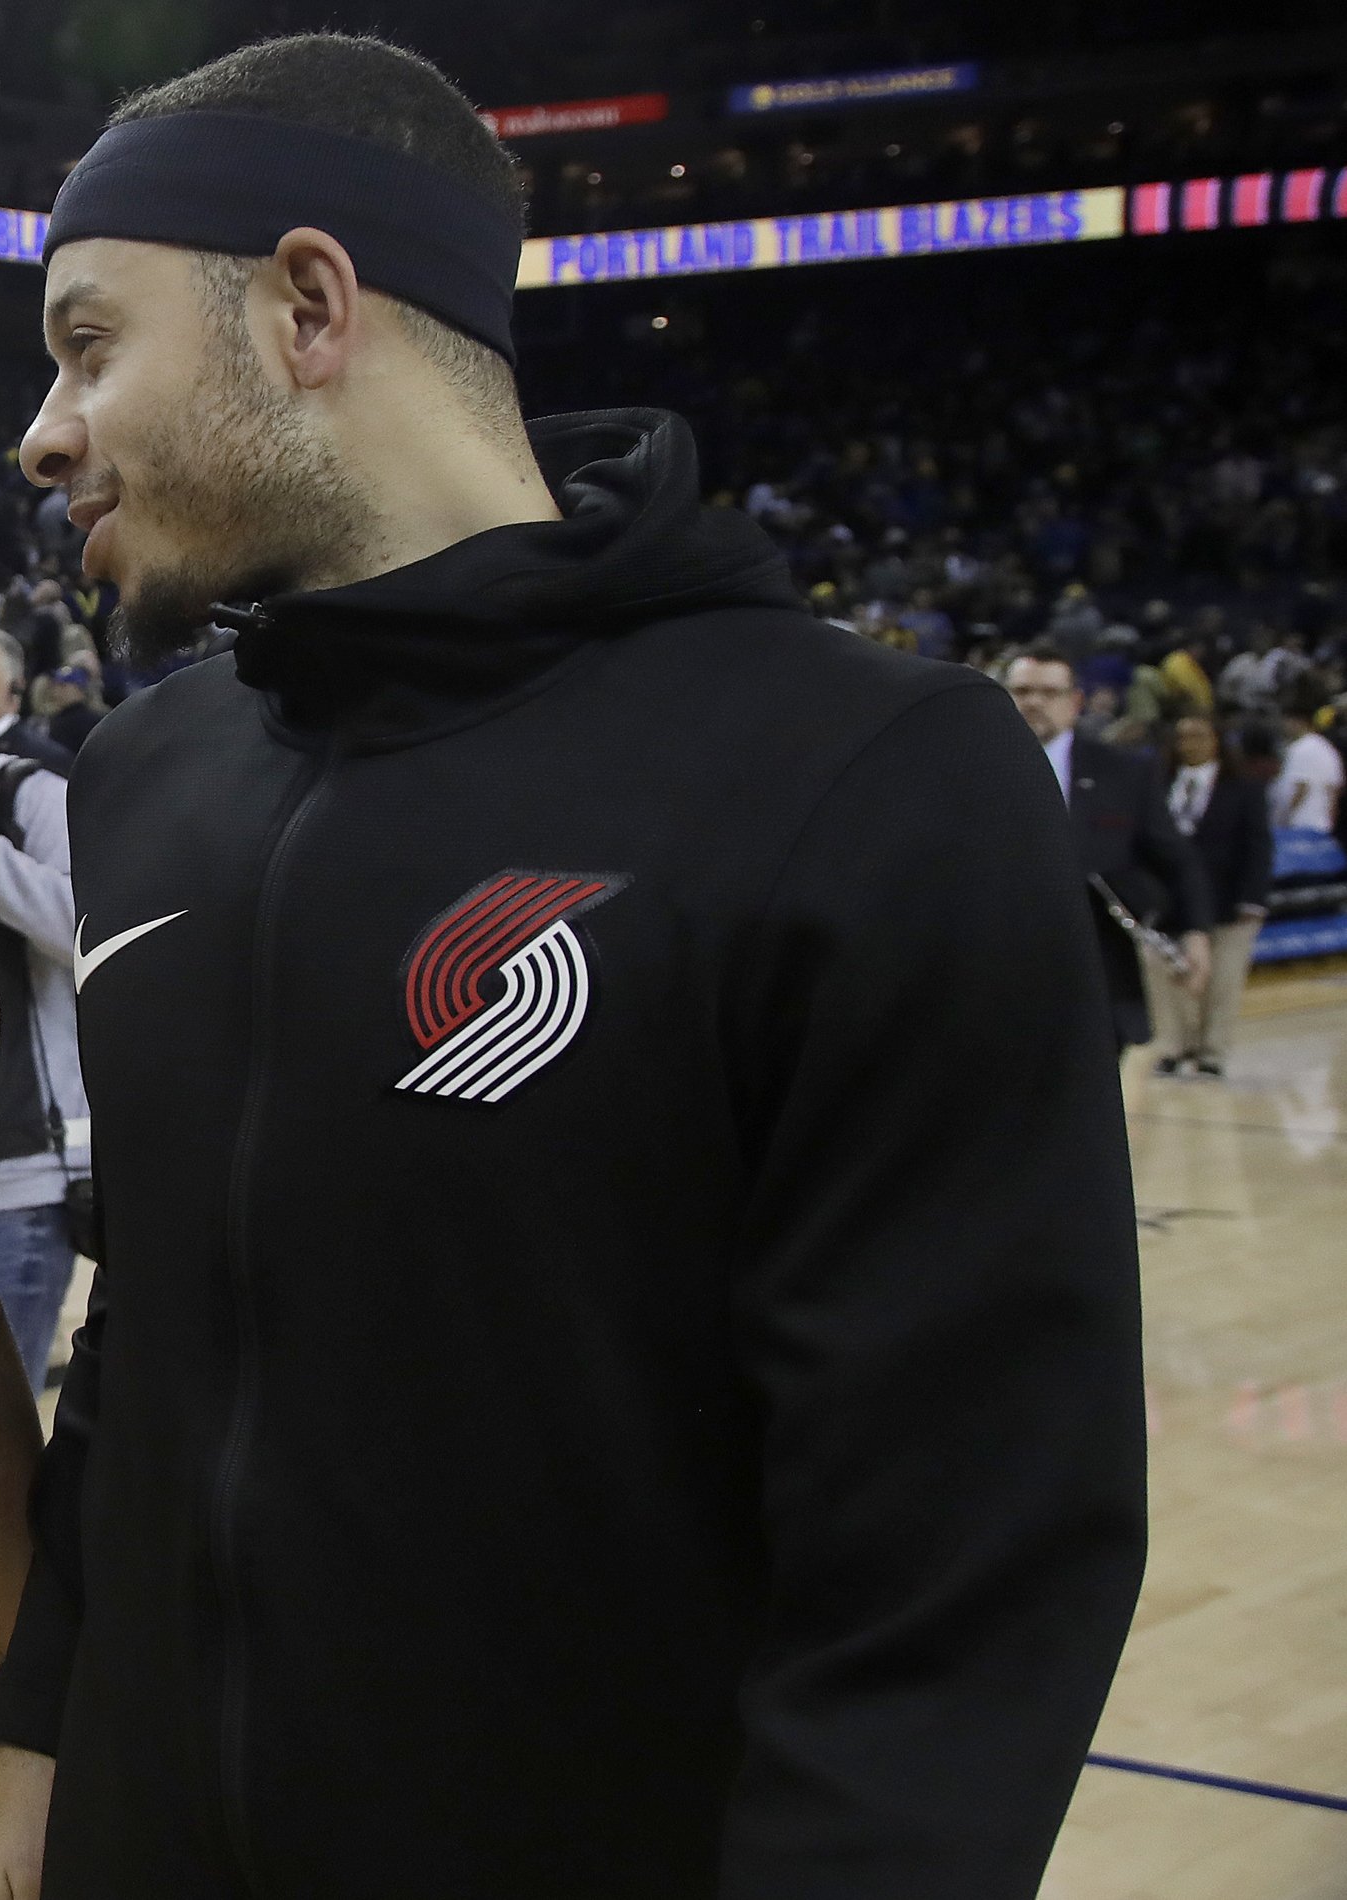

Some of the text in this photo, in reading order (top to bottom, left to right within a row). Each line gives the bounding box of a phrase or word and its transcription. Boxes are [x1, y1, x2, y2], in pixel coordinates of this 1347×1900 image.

[550, 190, 1081, 284] PORTLAND TRAIL BLAZERS
